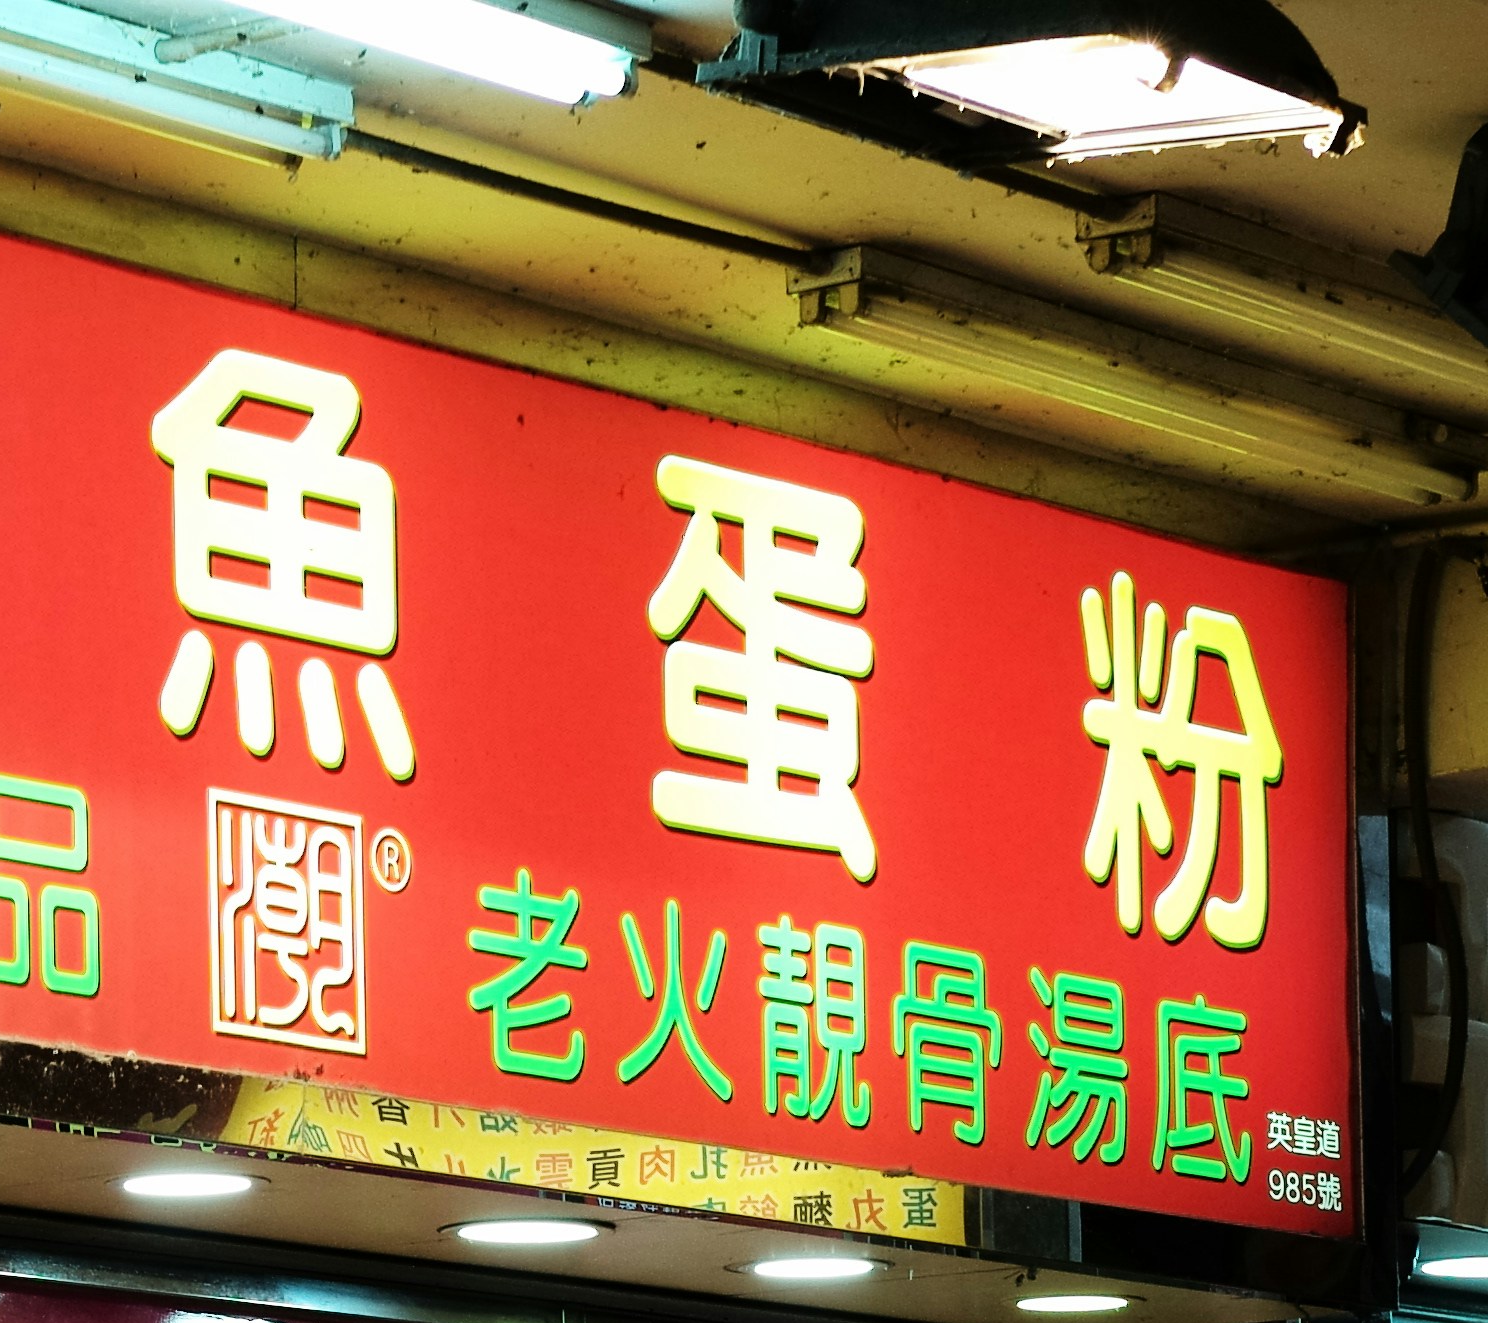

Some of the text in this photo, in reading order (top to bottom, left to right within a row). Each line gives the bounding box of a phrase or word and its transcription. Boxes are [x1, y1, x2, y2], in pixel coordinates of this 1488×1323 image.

[468, 869, 1251, 1183] 老火靚骨湯底
[1266, 1110, 1341, 1159] 英皇道
[1267, 1169, 1342, 1213] 985號
